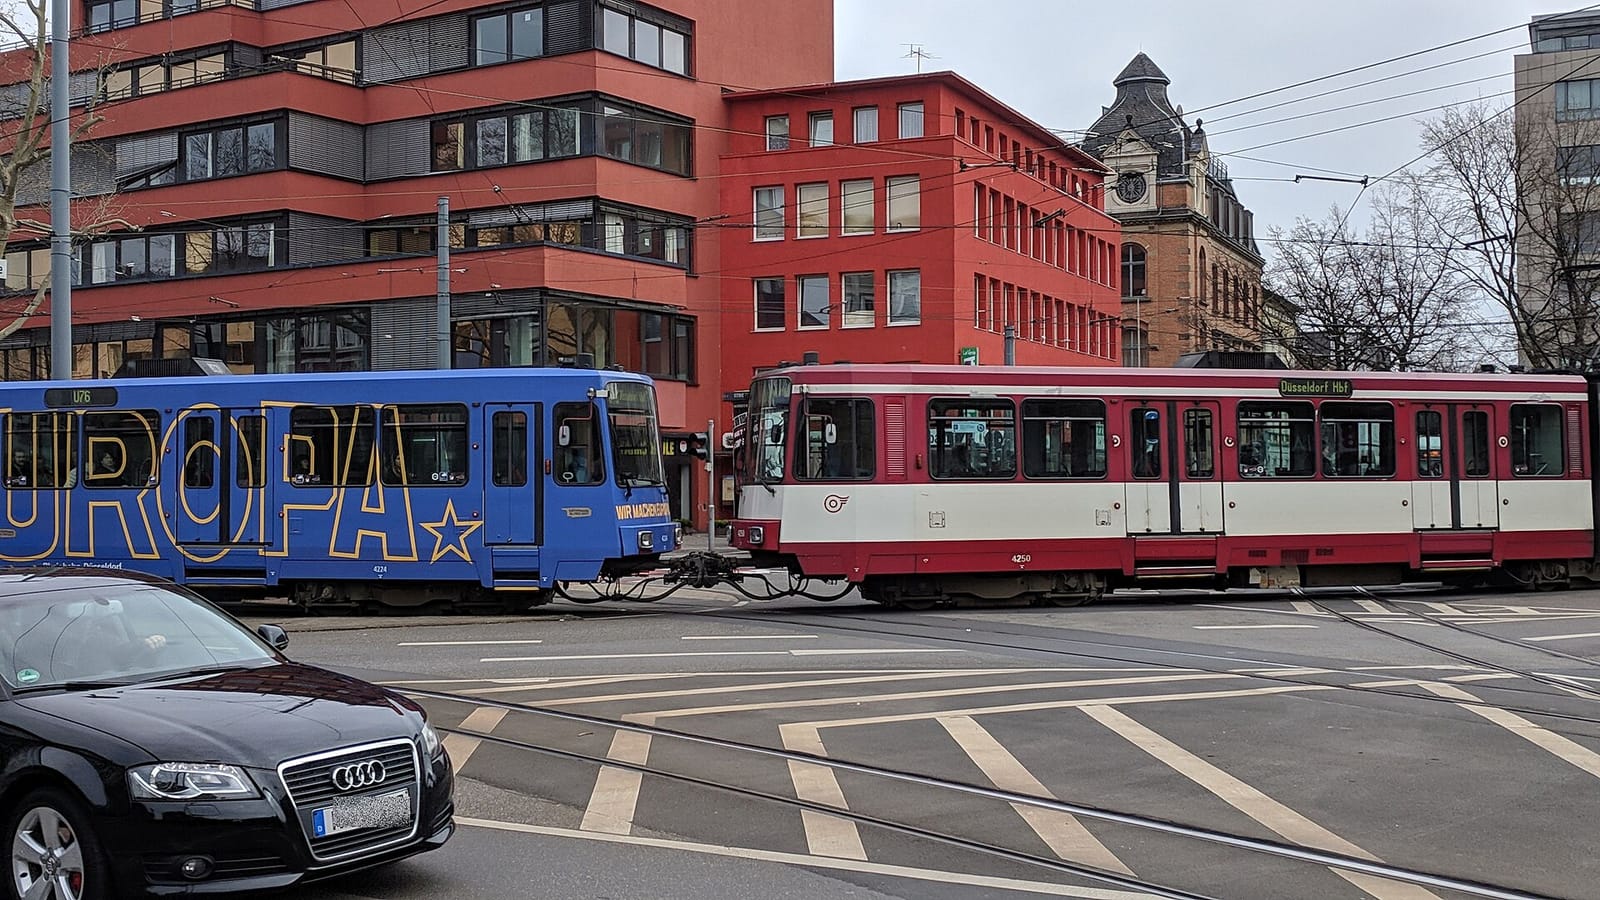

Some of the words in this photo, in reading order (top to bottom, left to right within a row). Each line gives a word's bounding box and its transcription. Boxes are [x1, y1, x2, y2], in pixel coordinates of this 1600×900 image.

[1281, 380, 1329, 393] Düsseldorf
[1332, 380, 1349, 393] Hbf
[73, 390, 91, 403] U76
[616, 504, 632, 520] WIR
[1011, 554, 1031, 563] 4250
